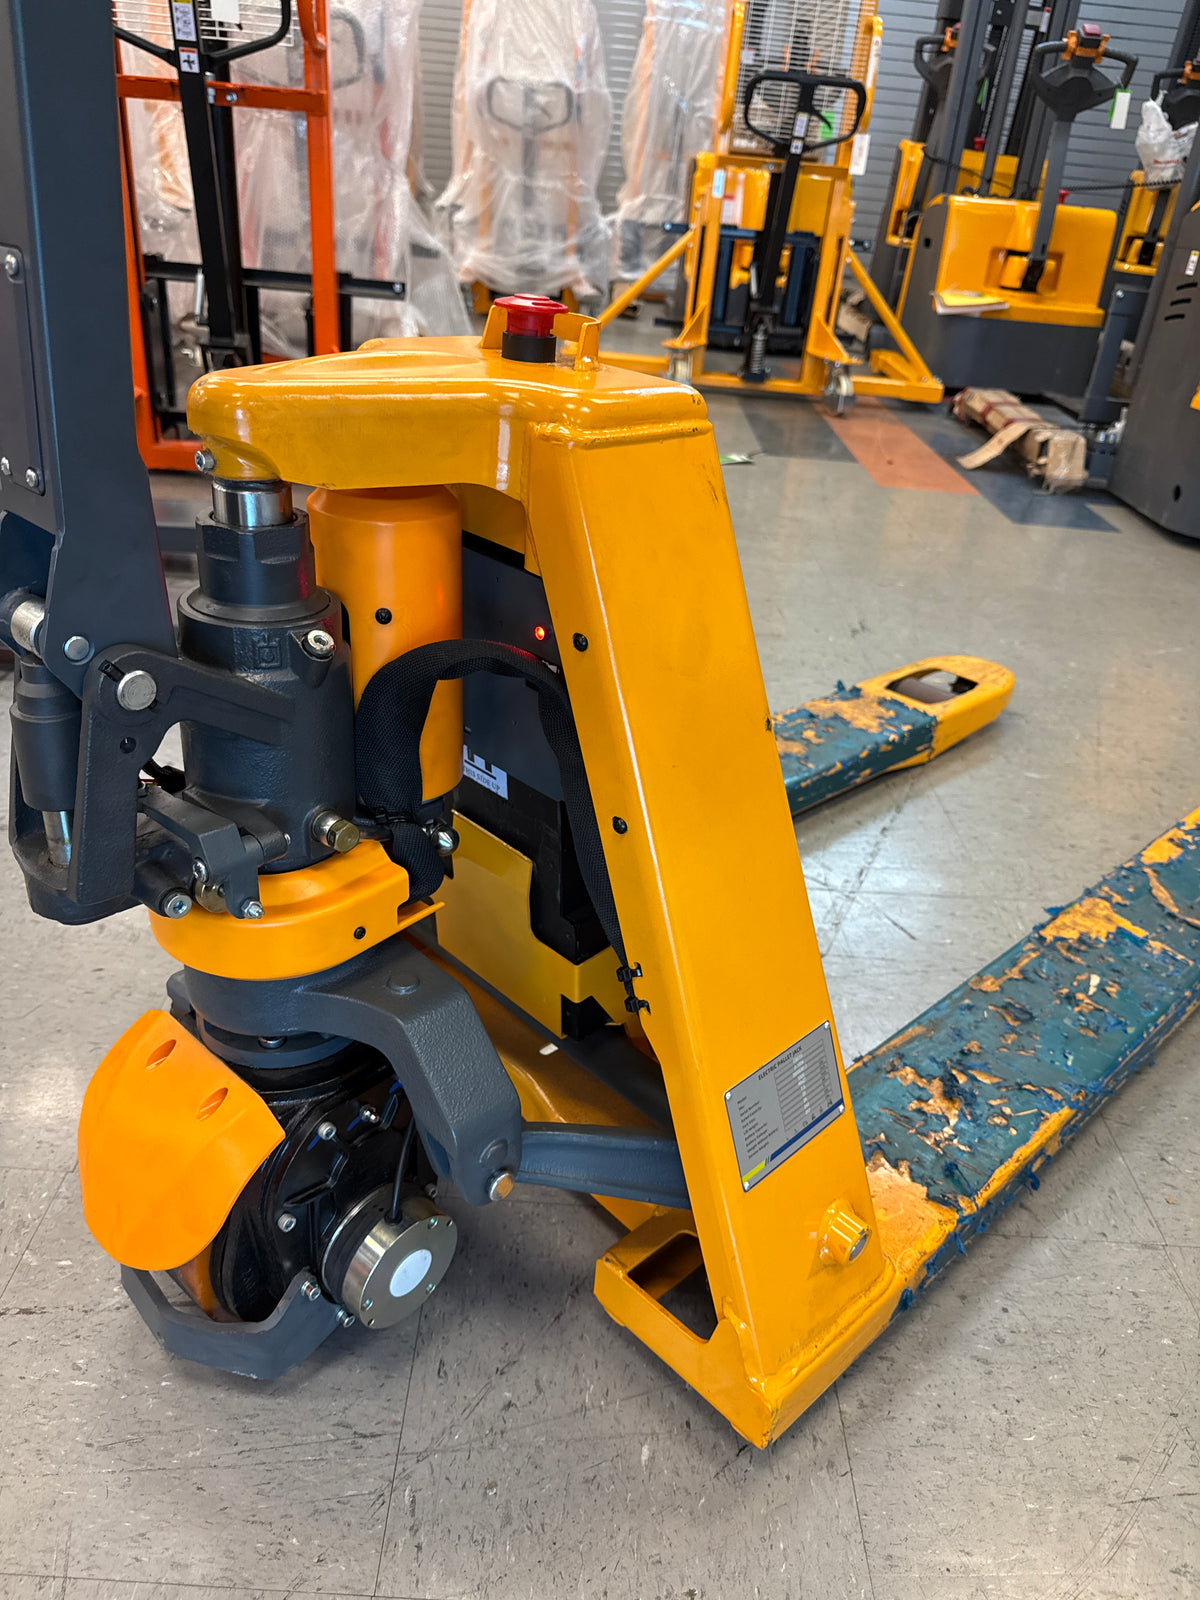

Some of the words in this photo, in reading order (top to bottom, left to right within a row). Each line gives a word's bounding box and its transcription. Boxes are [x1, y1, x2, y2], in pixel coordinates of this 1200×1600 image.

[476, 773, 491, 787] SIDE
[491, 781, 501, 791] UP
[757, 1062, 777, 1080] ELECTRIC
[777, 1052, 792, 1067] PALLET
[792, 1045, 802, 1058] JACK
